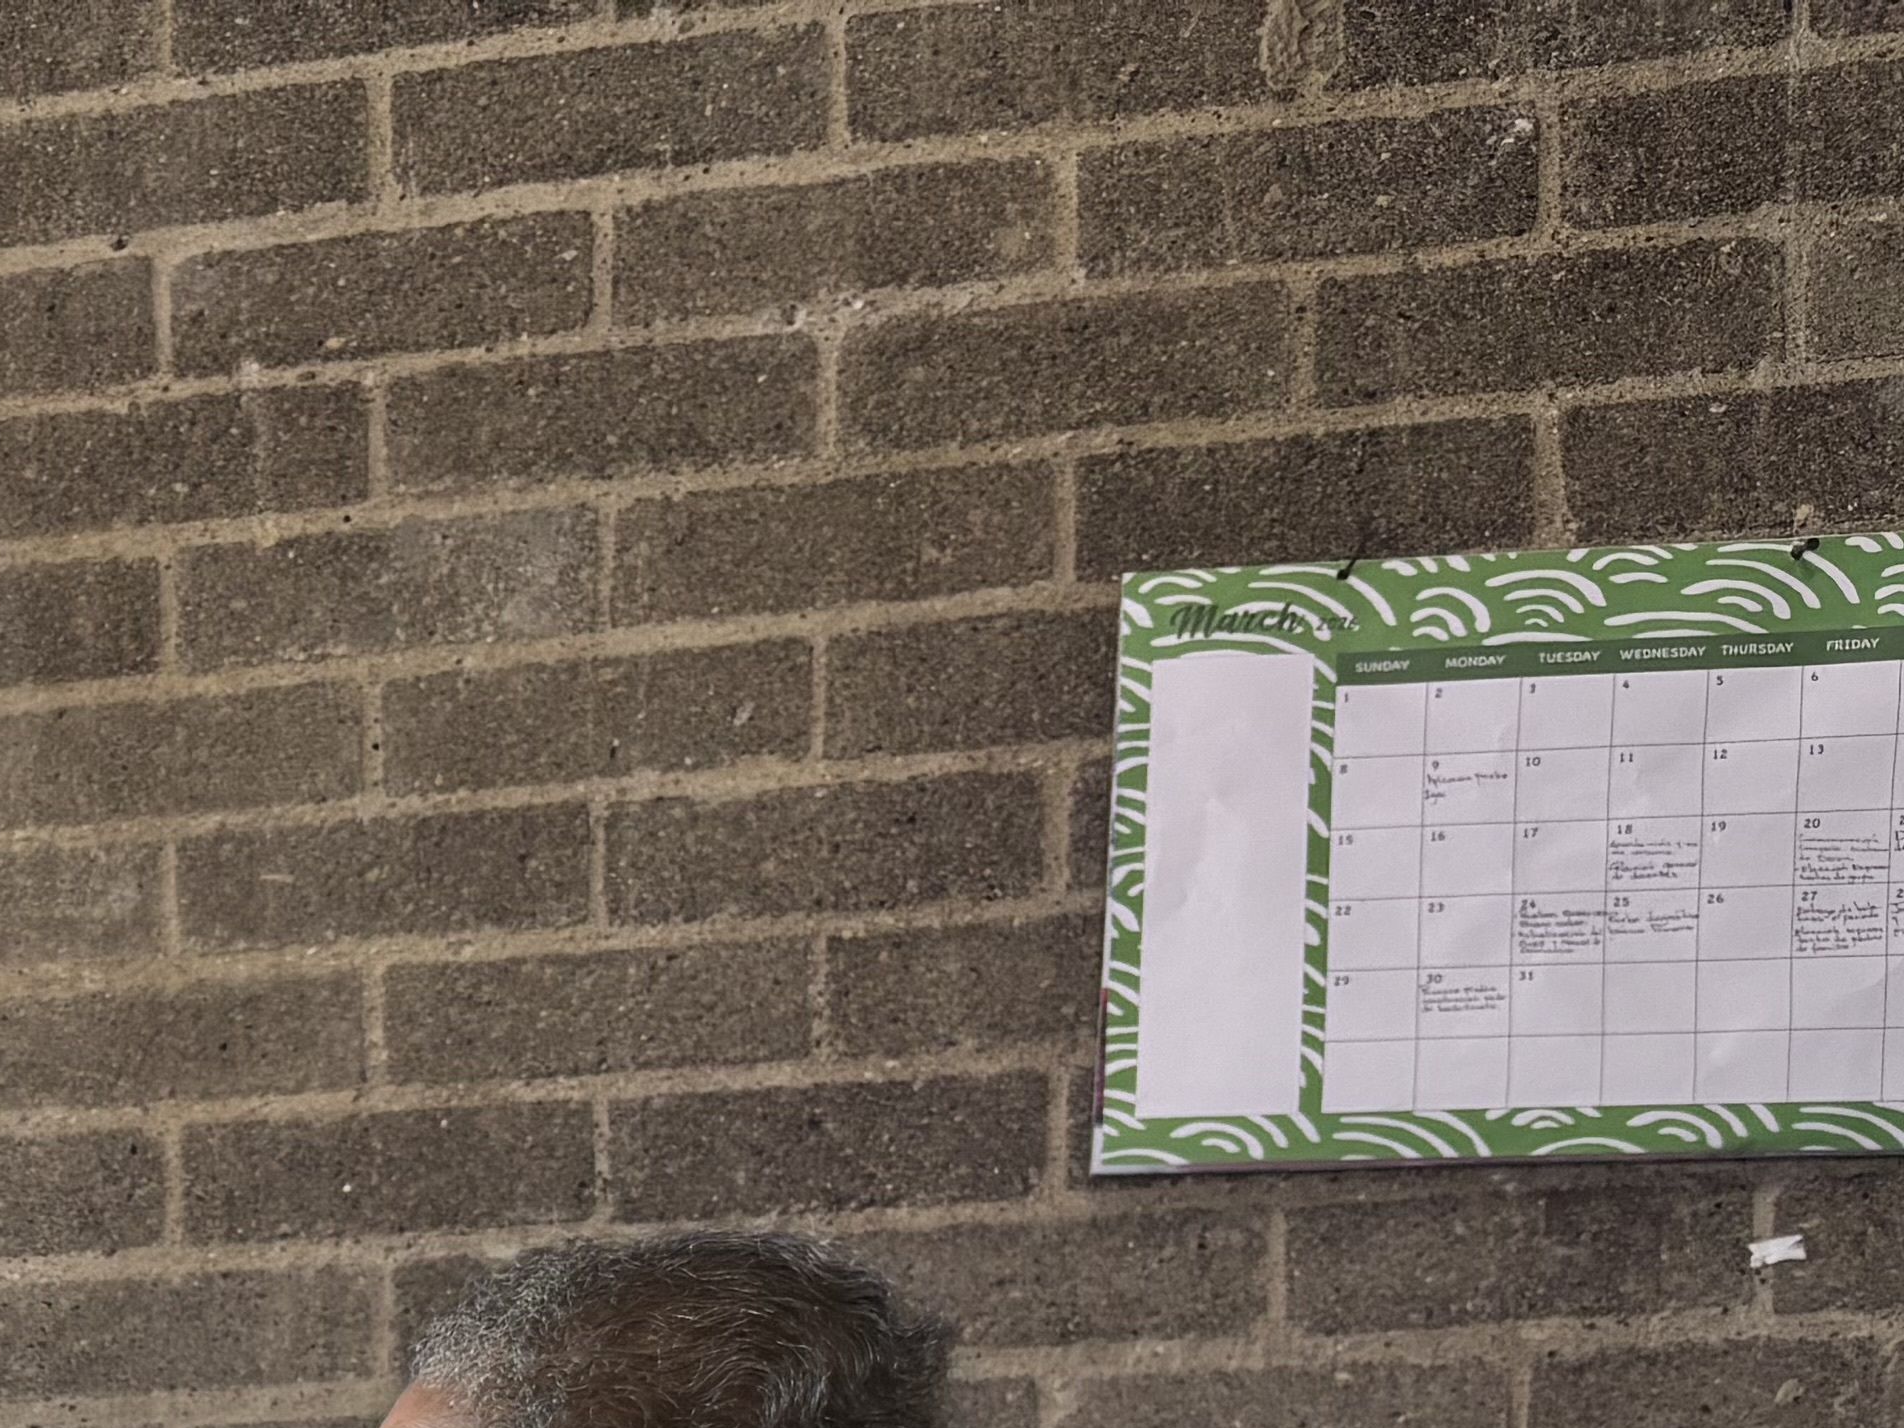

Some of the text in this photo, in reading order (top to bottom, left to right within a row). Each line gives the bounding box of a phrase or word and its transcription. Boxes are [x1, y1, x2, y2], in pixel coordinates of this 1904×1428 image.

[1170, 601, 1298, 640] March
[1355, 637, 1880, 673] SUNDAY MONDAY TUESDAY WEDNESDAY THURSDAY FRIDAY
[1525, 756, 1541, 767] 10
[1619, 752, 1634, 763] 11
[1712, 748, 1728, 760] 12
[1809, 744, 1825, 755] 13
[1337, 834, 1353, 845] 15
[1430, 831, 1445, 842] 16
[1523, 827, 1538, 838] 17
[1617, 824, 1633, 835] 18
[1711, 820, 1726, 832] 19
[1803, 818, 1821, 829] 20
[1335, 905, 1351, 916] 22
[1428, 902, 1445, 913] 23
[1521, 899, 1536, 912] 24
[1613, 896, 1630, 907] 25
[1707, 893, 1724, 904] 26
[1801, 890, 1818, 902] 27
[1334, 970, 1534, 986] 29 30 31
